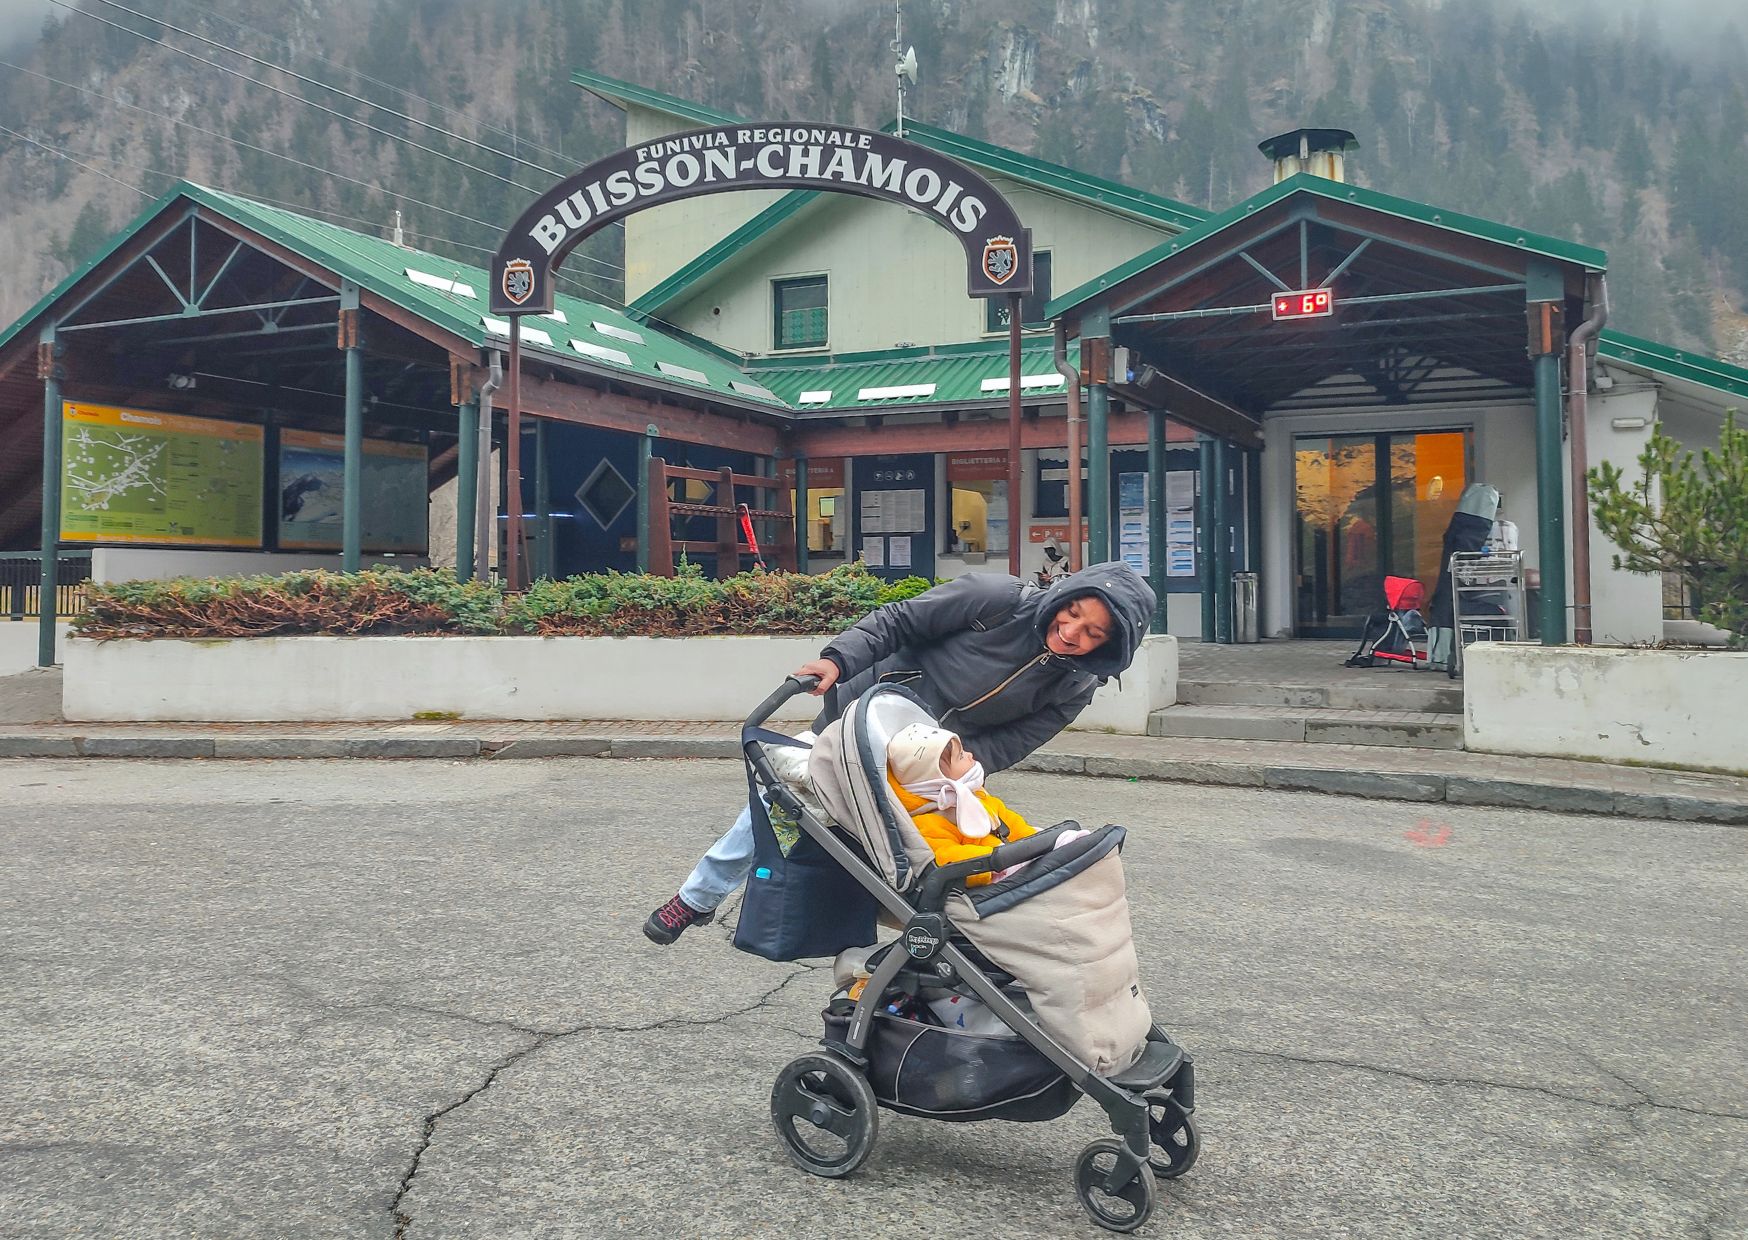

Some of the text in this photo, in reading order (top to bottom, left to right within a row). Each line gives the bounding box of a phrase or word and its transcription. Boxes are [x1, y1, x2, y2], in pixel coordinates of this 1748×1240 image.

[635, 128, 872, 163] FUNIVIA REGIONALE
[528, 144, 987, 256] BUISSON-CHAMOIS
